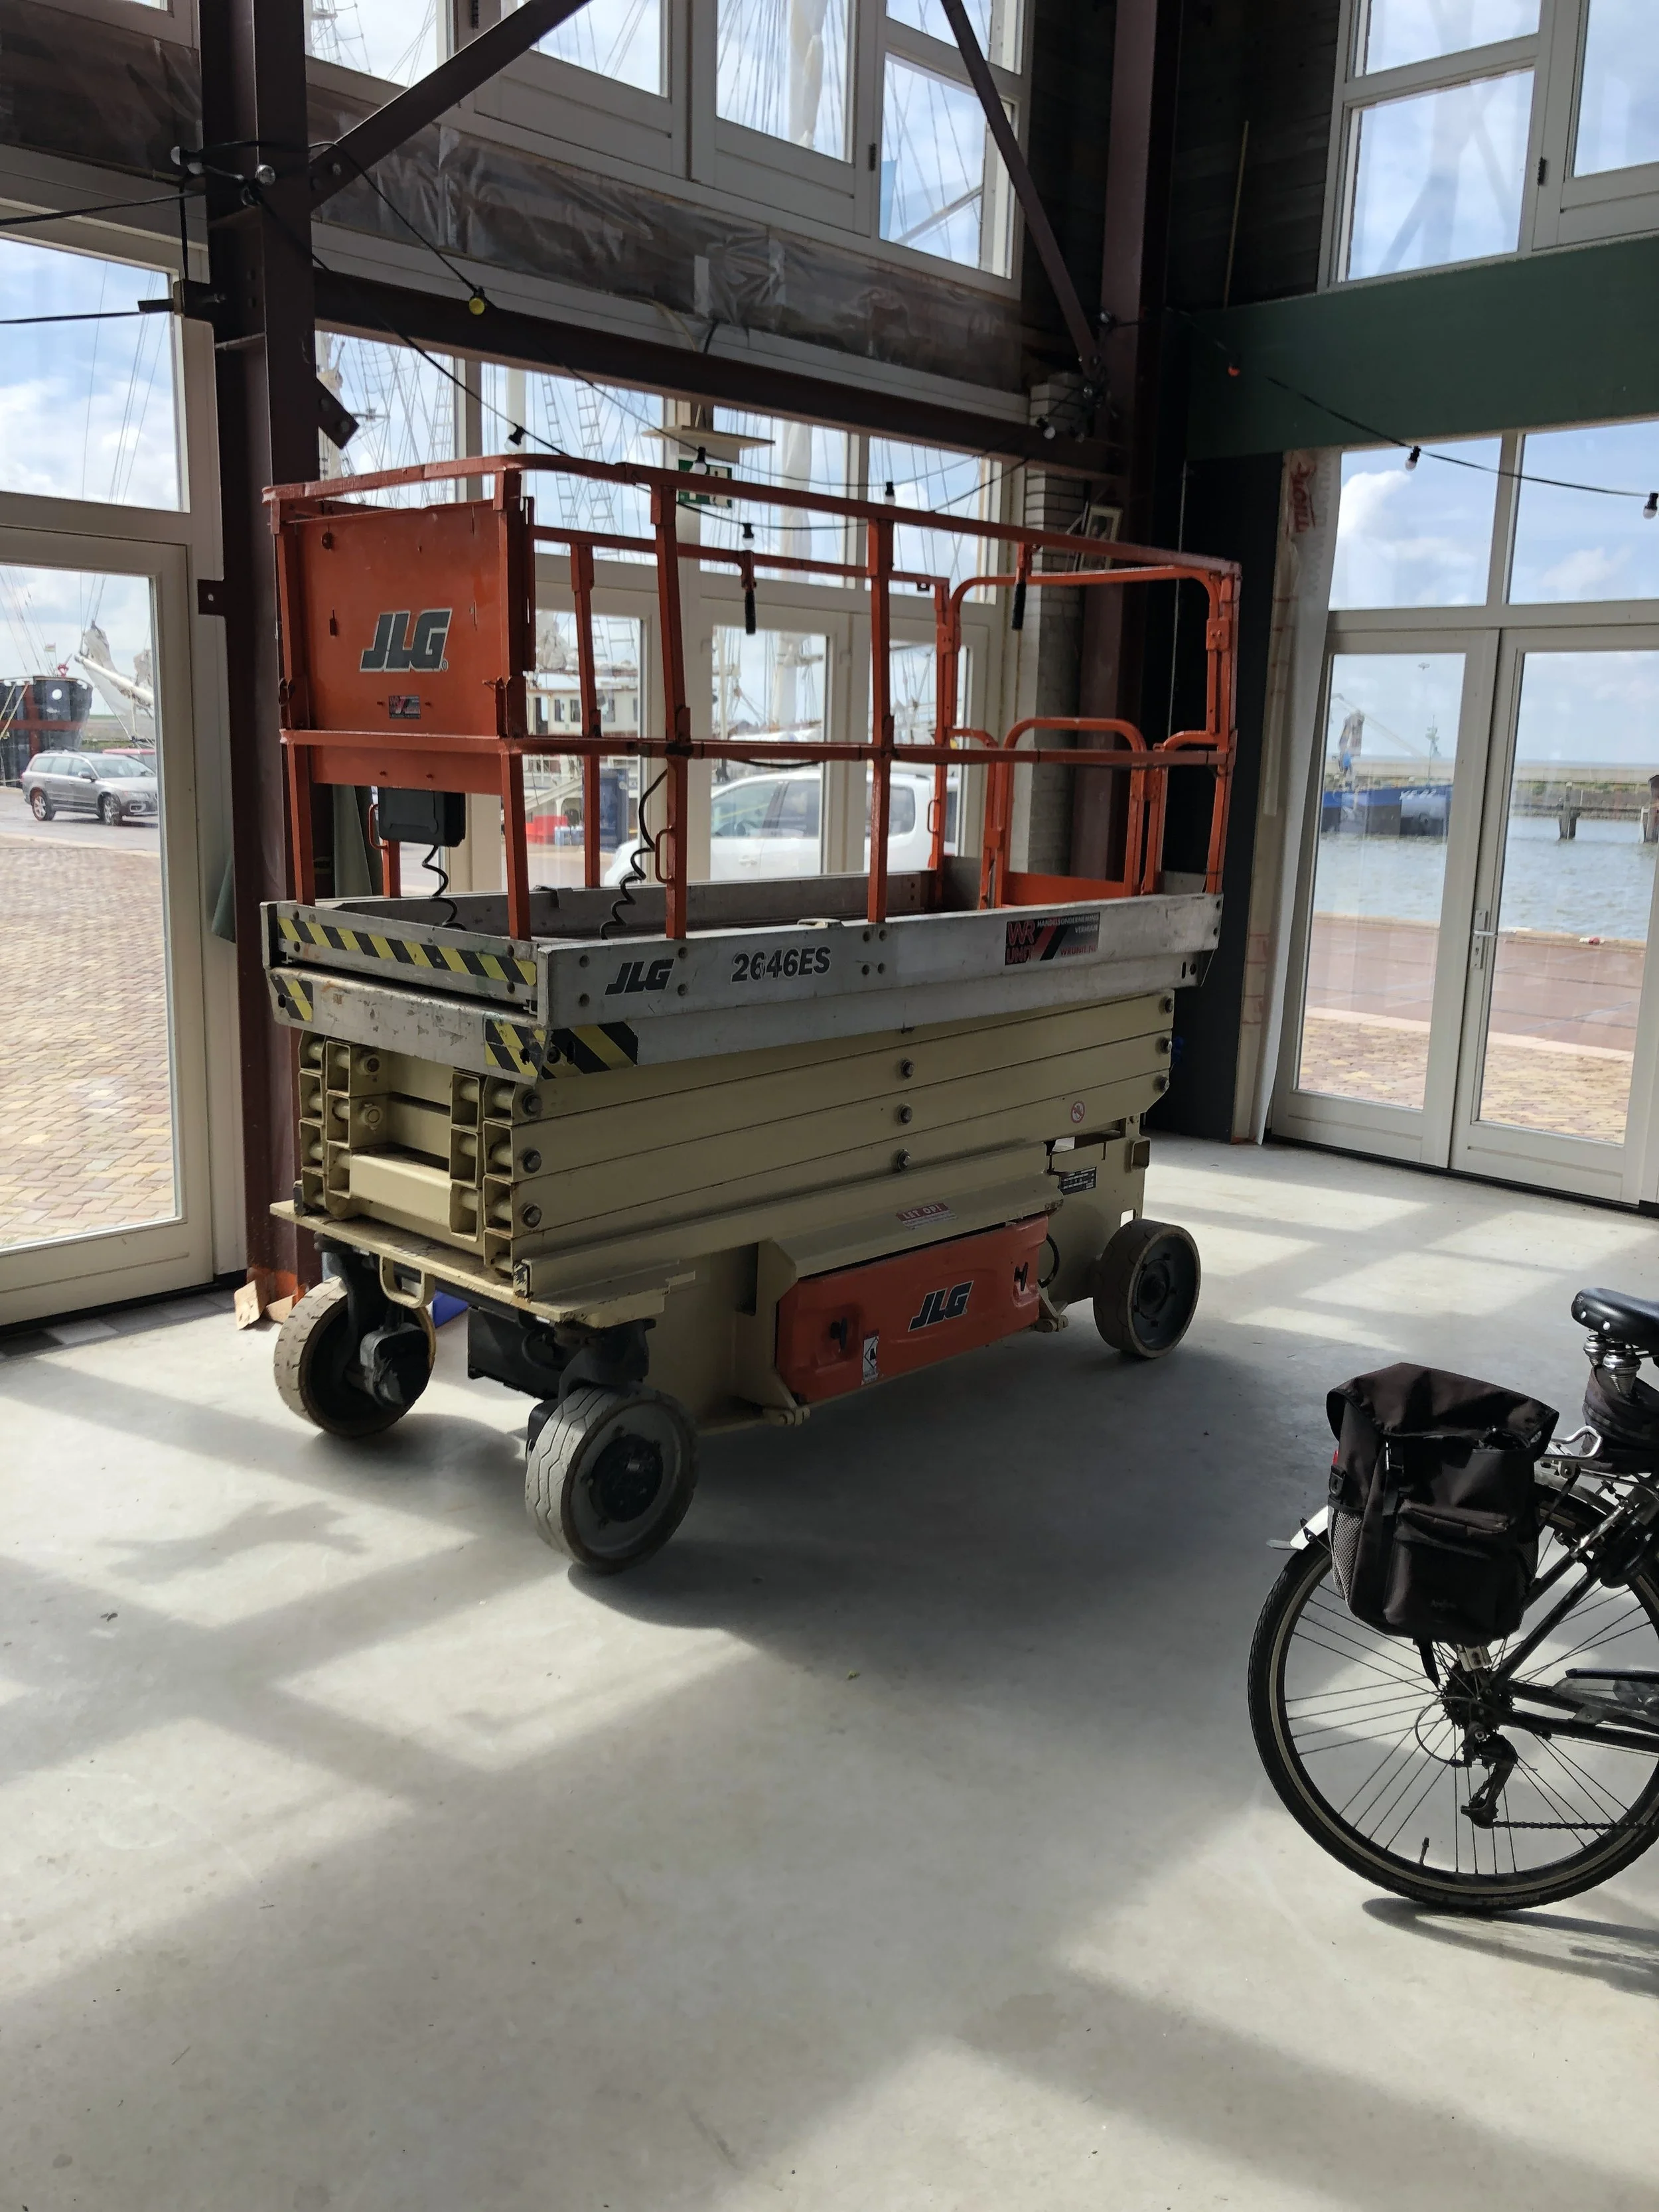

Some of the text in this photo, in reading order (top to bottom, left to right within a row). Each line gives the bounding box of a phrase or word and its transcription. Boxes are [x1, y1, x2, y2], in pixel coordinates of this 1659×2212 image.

[360, 607, 453, 672] JLG
[1008, 921, 1035, 945] WR
[605, 946, 831, 995] JLG 2646ES
[1007, 946, 1031, 963] UNIT
[902, 1204, 942, 1219] LET OP!
[908, 1280, 974, 1332] JLG
